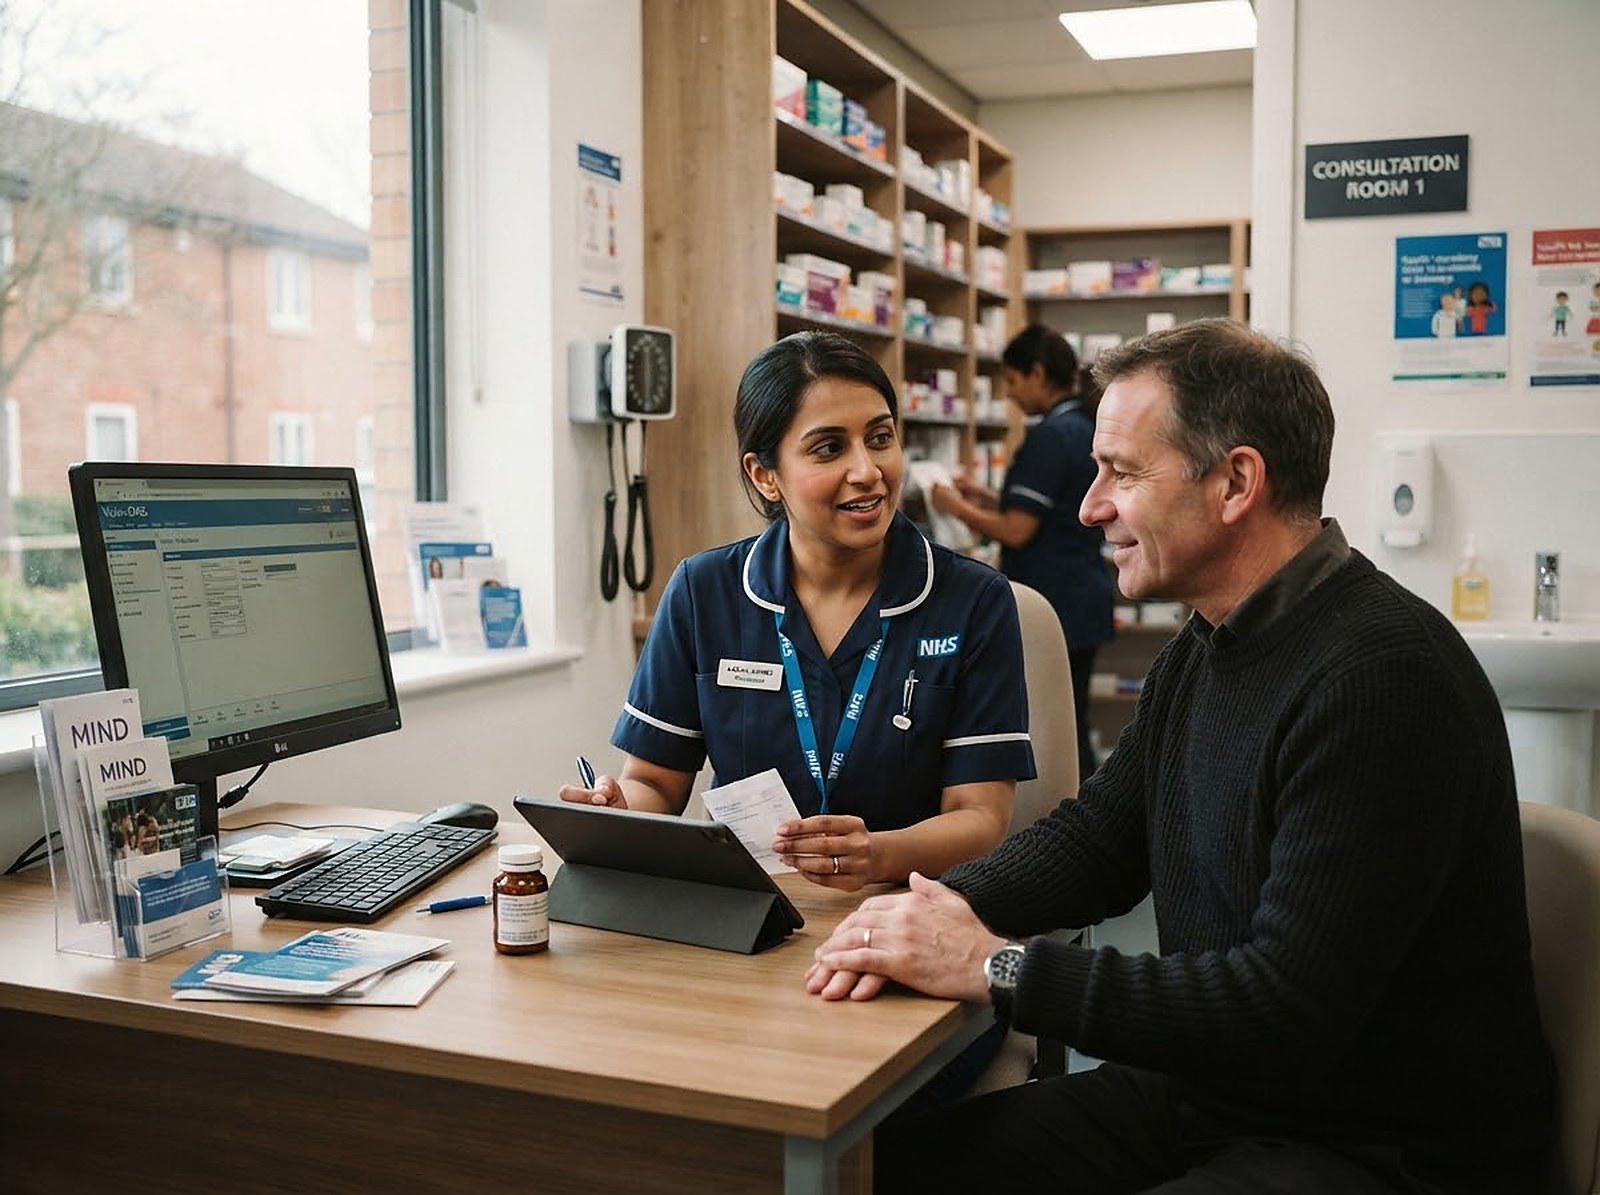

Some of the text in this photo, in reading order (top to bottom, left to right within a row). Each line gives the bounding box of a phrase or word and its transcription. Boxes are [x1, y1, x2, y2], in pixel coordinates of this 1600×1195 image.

[1312, 153, 1460, 180] CONSULTATION
[1346, 178, 1425, 199] ROOM 1
[919, 635, 959, 656] NHS
[71, 717, 129, 749] MIND
[99, 757, 147, 783] MIND
